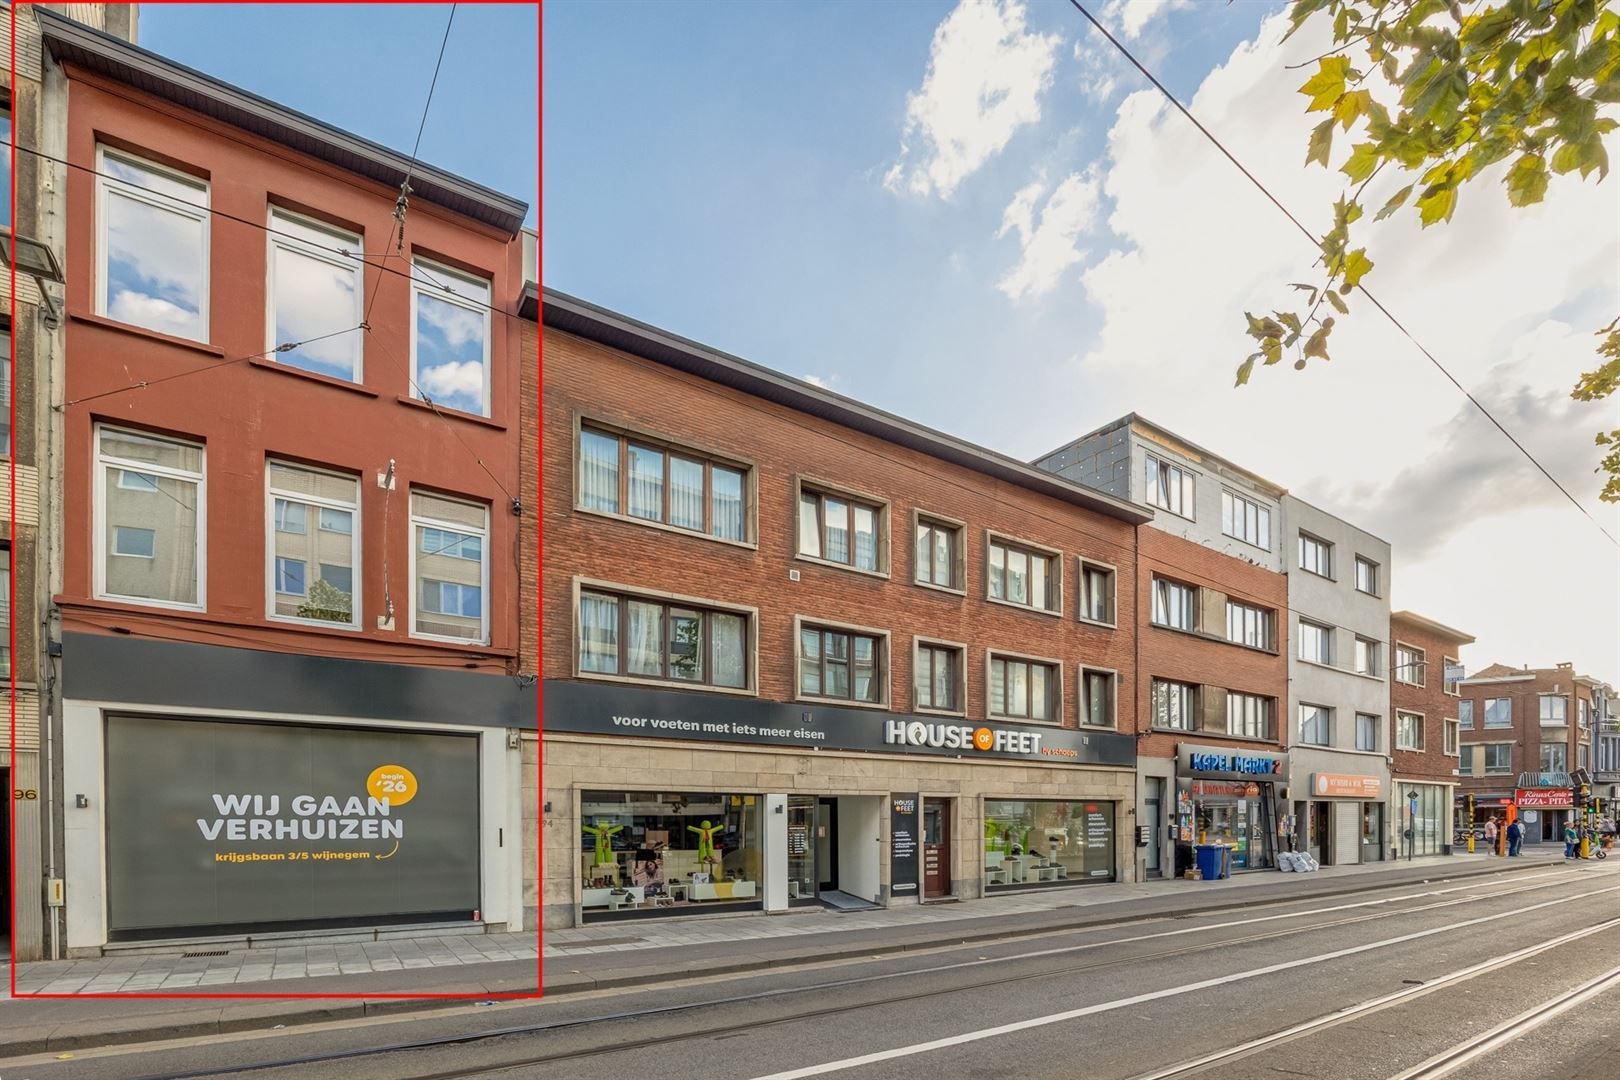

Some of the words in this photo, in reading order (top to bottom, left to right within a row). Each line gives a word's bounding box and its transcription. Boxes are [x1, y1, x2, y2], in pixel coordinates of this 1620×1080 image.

[612, 715, 647, 727] voor
[650, 718, 699, 731] voeten
[702, 722, 730, 733] met
[732, 722, 756, 735] iets
[759, 727, 791, 737] meer
[793, 728, 825, 740] eisen
[884, 720, 974, 749] HOUSE
[979, 735, 990, 743] OF
[993, 730, 1042, 754] FEET
[1273, 758, 1282, 776] 2
[212, 794, 280, 816] WIJ
[291, 795, 390, 816] GAAN
[196, 818, 404, 841] VERHUIZEN
[215, 852, 285, 863] krijgsbaan
[288, 852, 309, 861] 3/5
[312, 851, 370, 862] wijnegem
